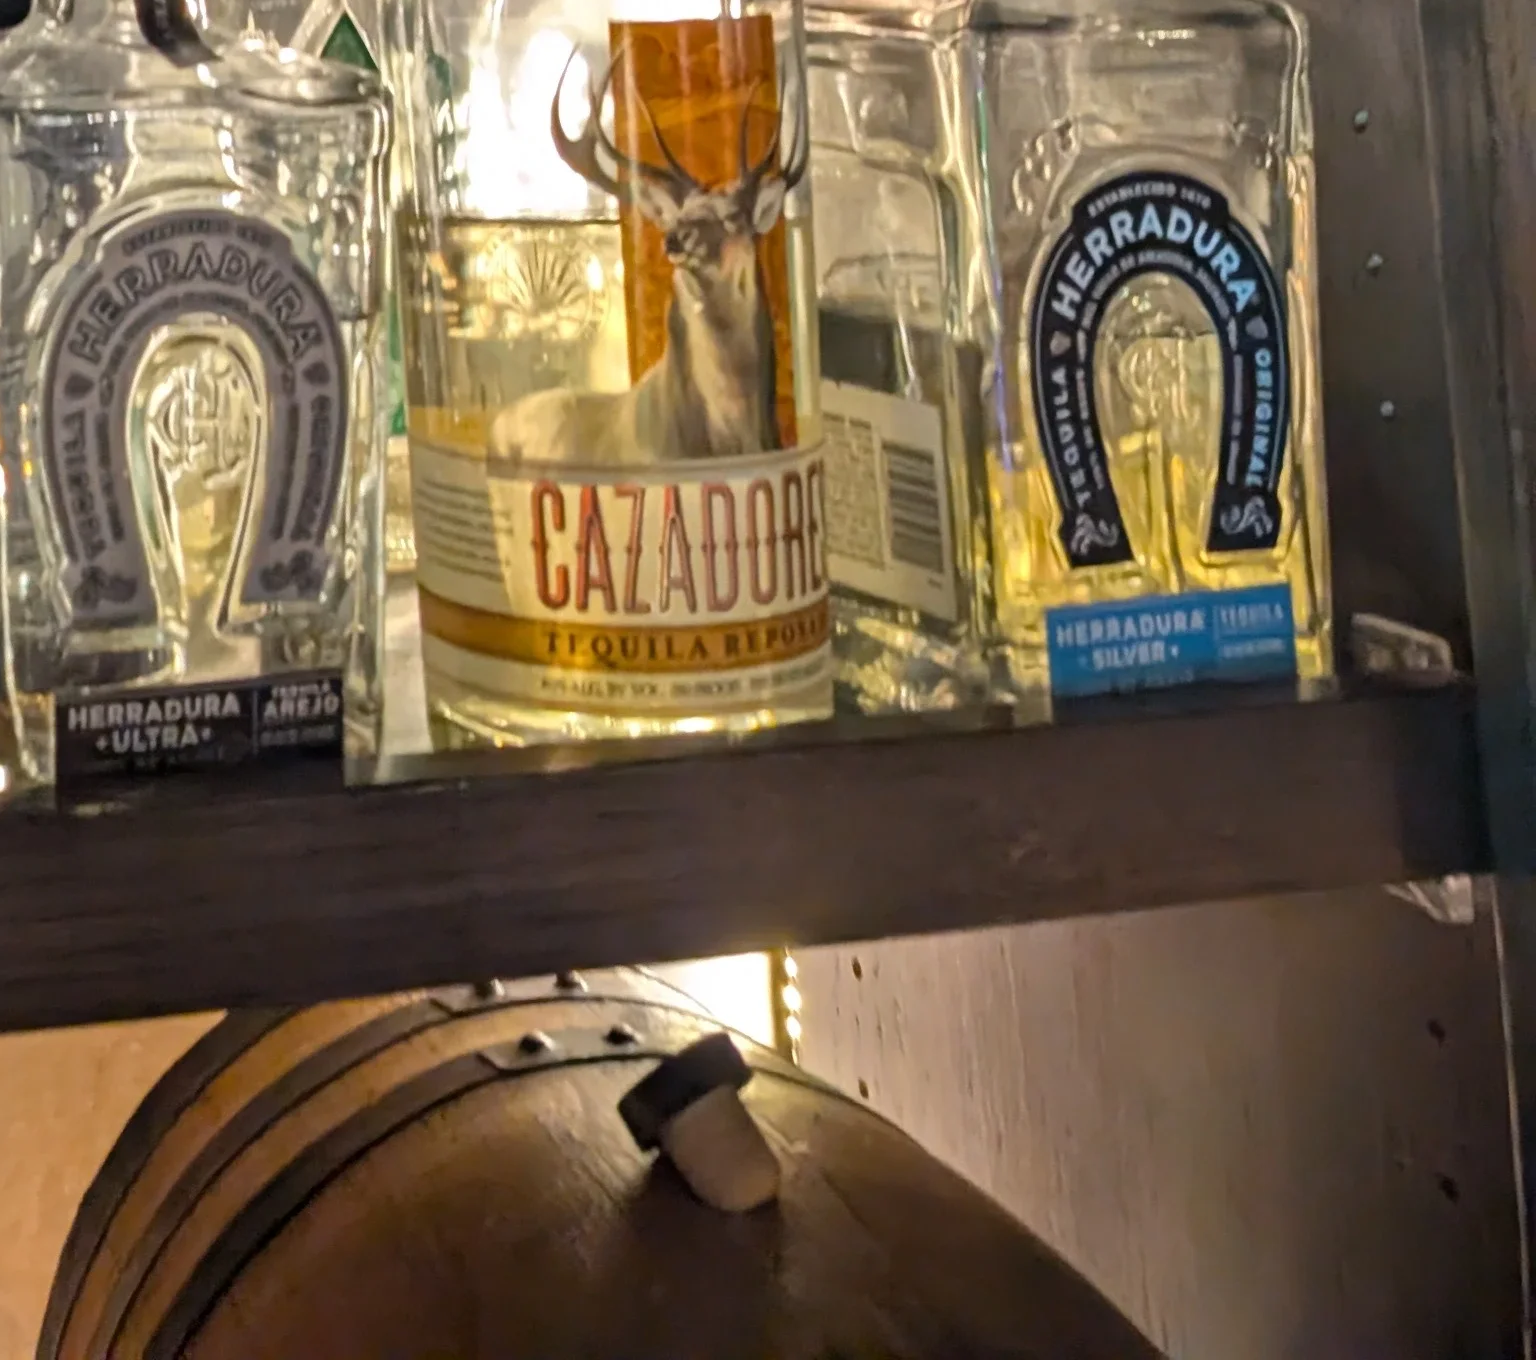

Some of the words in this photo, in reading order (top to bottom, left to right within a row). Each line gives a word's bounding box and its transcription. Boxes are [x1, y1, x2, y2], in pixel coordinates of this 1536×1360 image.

[66, 239, 322, 366] HERRADURA
[1050, 200, 1258, 321] HERRADURA
[1050, 364, 1093, 509] TEQUILA
[1244, 347, 1274, 487] ORIGINAL
[531, 456, 825, 614] CAZADORE
[1055, 608, 1207, 648] HERRADURA
[1092, 640, 1167, 672] SILVER
[67, 691, 241, 730] HERRADURA
[113, 722, 200, 753] ULTRA
